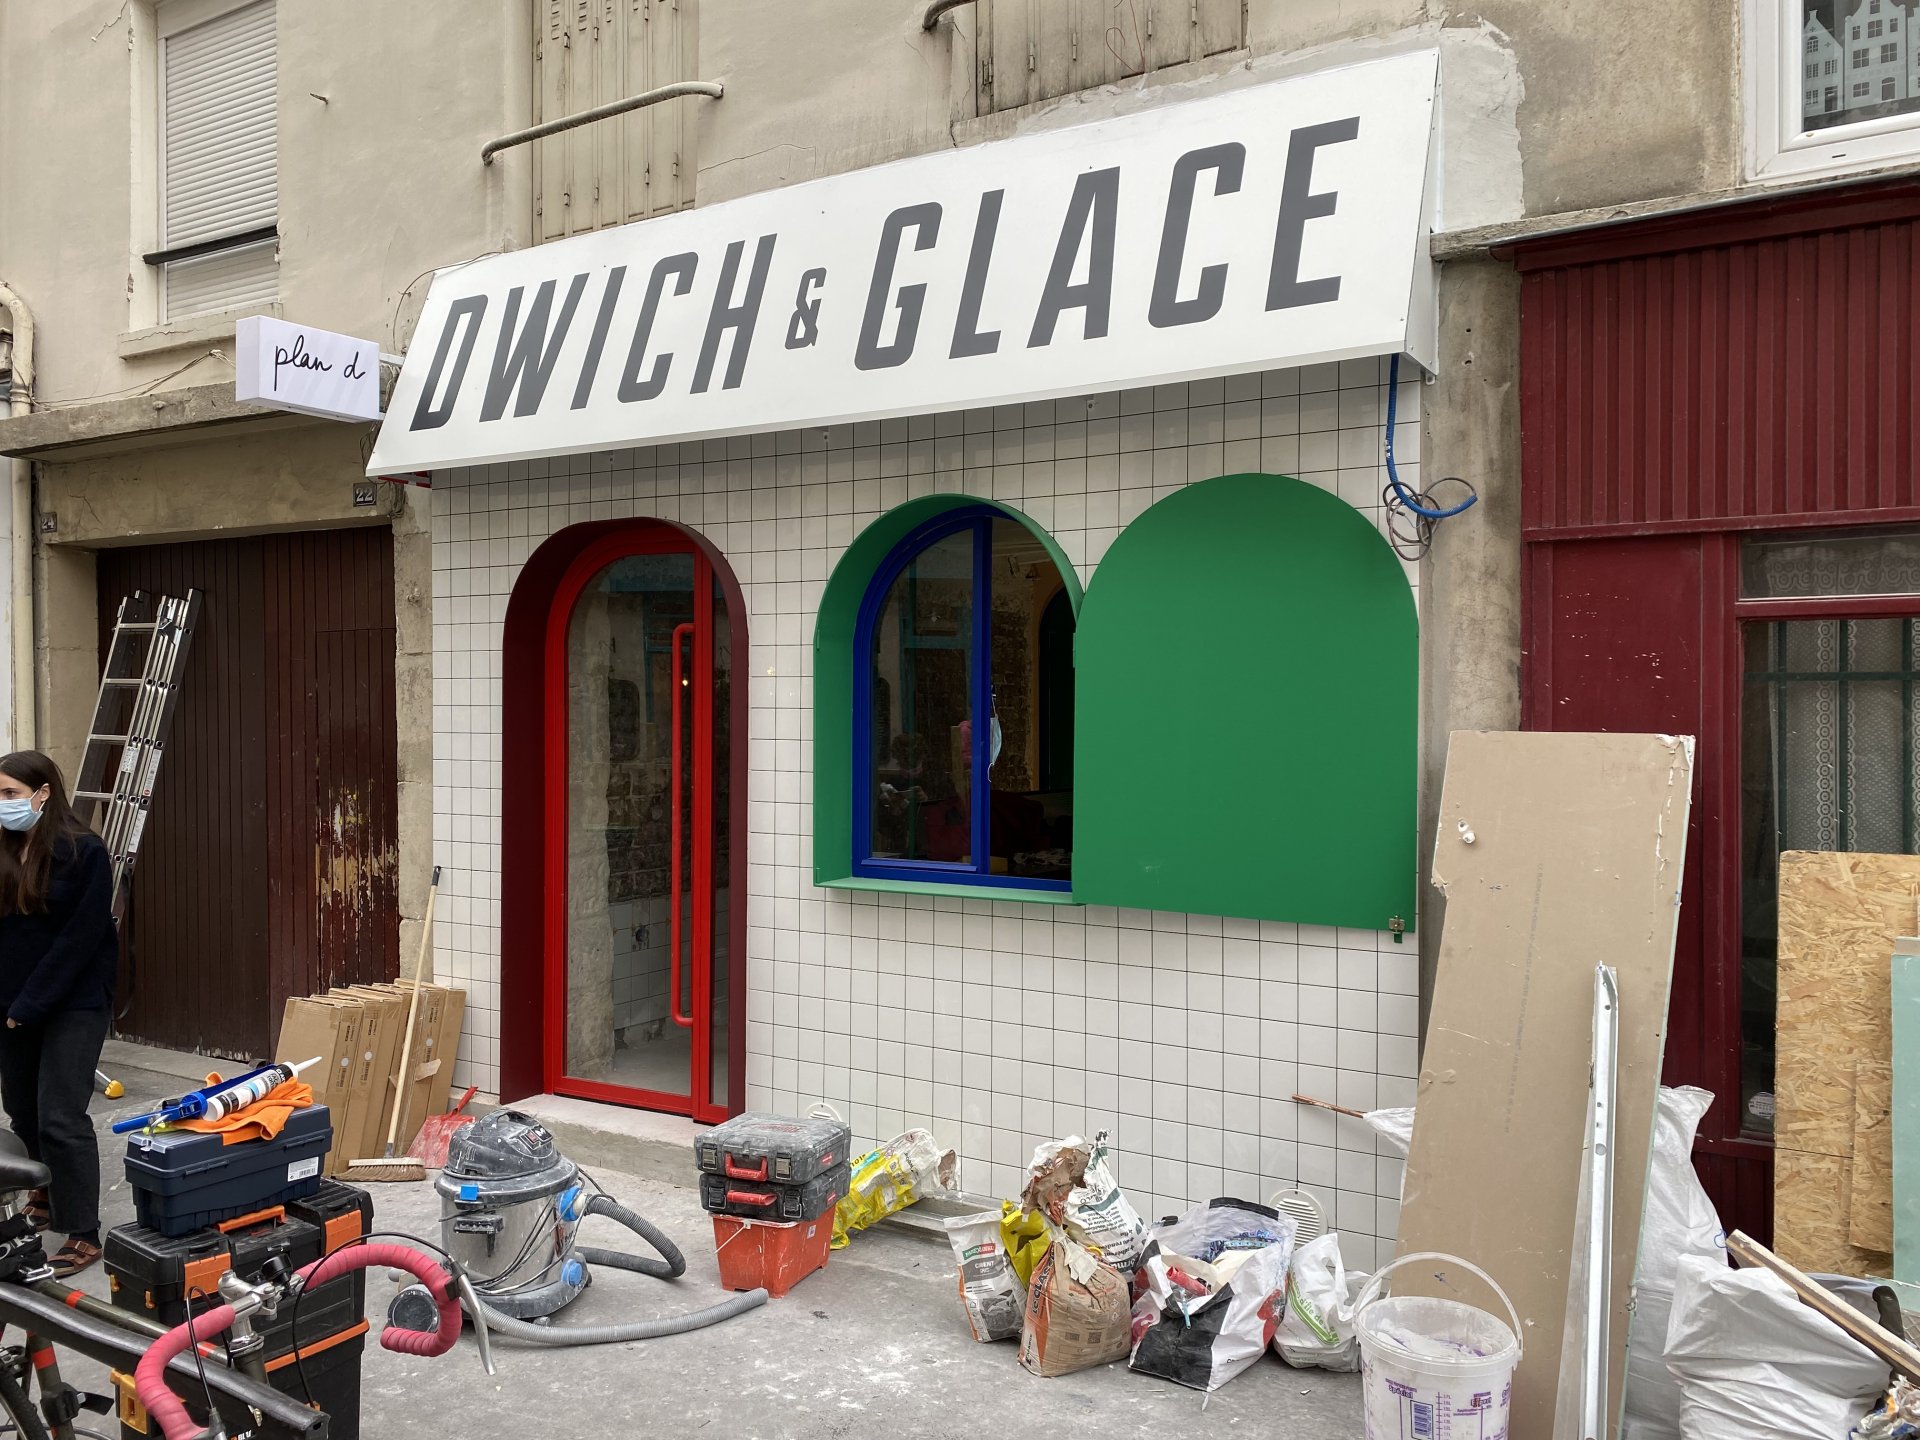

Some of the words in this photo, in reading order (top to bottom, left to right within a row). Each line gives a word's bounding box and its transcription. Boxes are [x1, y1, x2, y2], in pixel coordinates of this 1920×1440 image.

[409, 234, 777, 431] DWICH
[785, 268, 827, 350] &
[854, 116, 1361, 371] GLACE
[274, 334, 333, 391] plan
[344, 351, 366, 380] d
[356, 487, 373, 502] 22
[41, 516, 55, 529] 24
